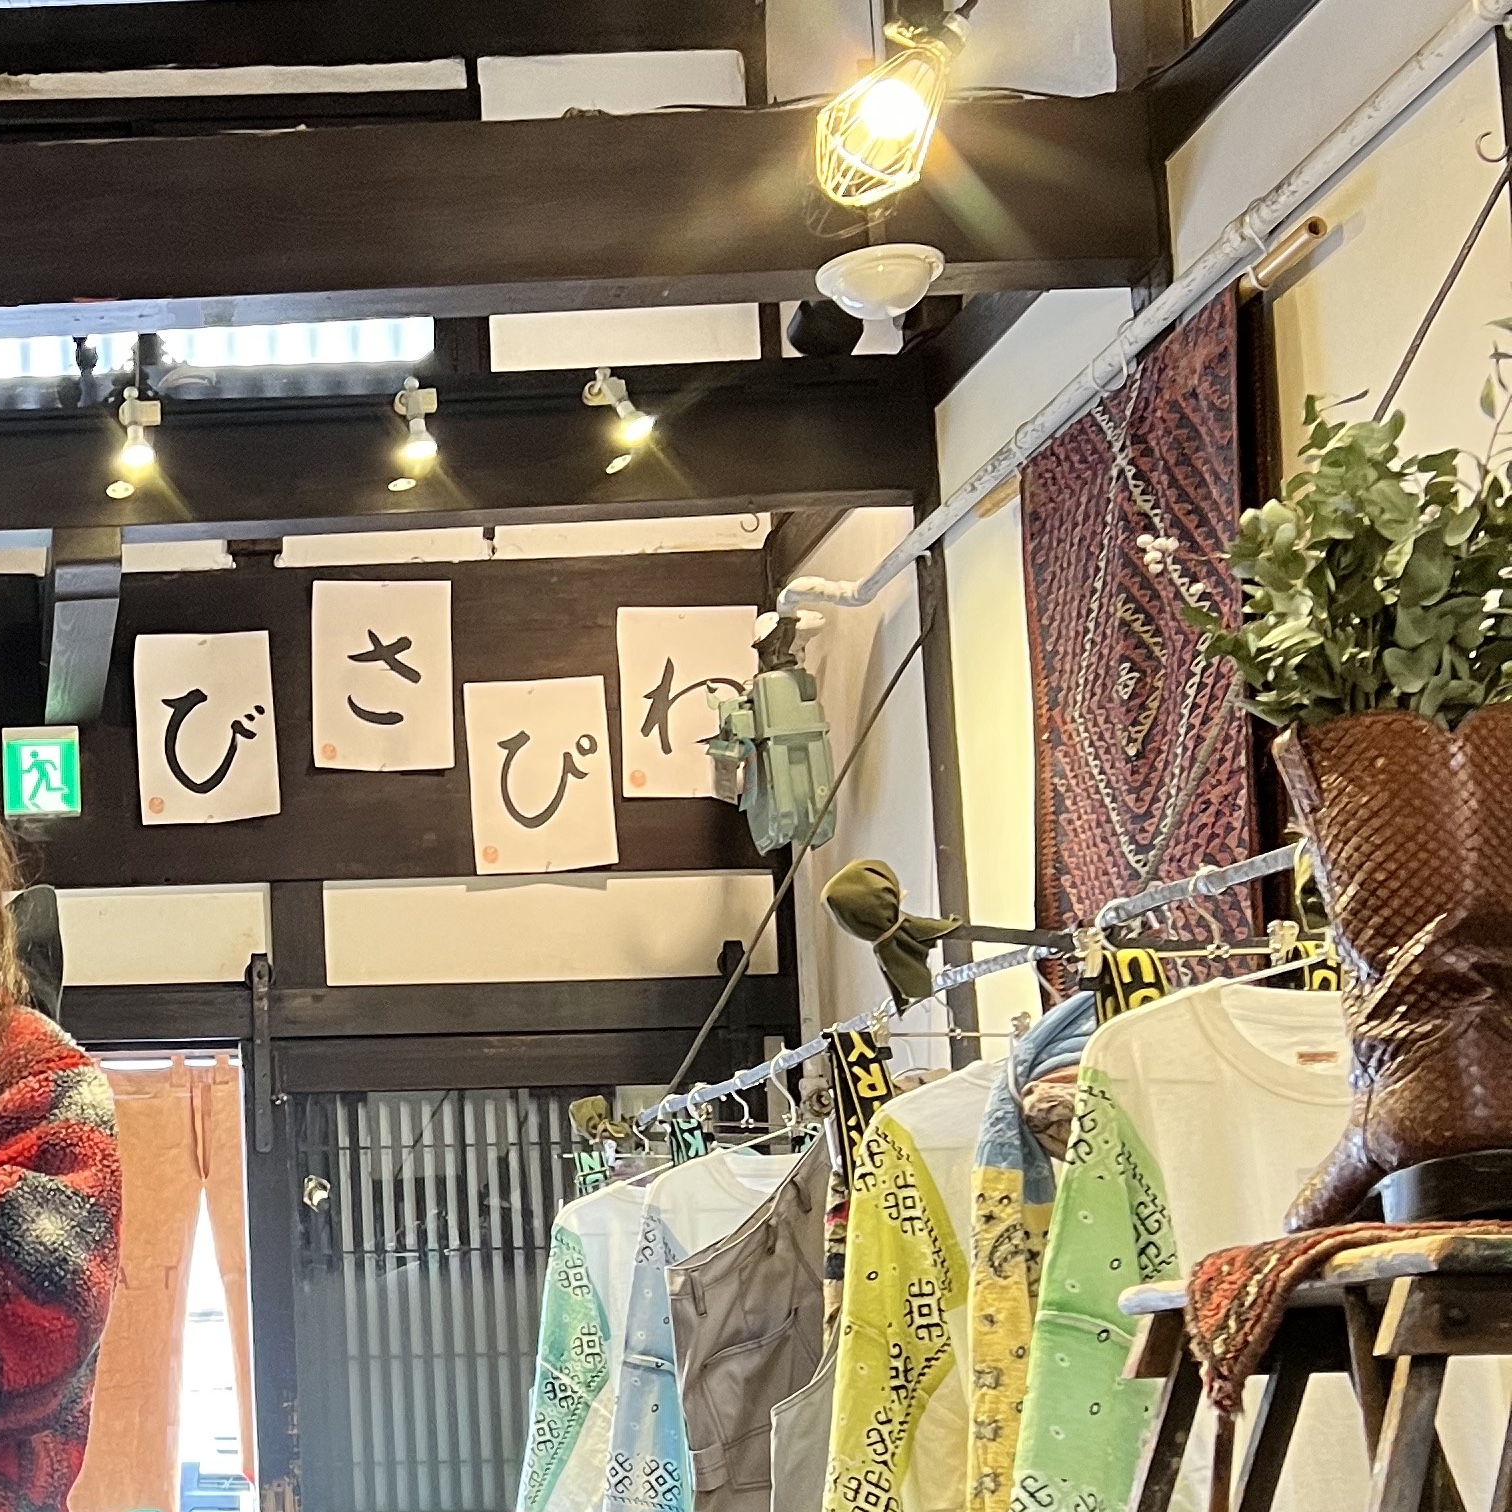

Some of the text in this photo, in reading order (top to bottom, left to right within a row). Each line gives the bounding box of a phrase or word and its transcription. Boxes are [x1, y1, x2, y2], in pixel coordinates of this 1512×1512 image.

[347, 628, 422, 725] さ
[161, 687, 266, 794] び
[497, 729, 599, 829] ぴ
